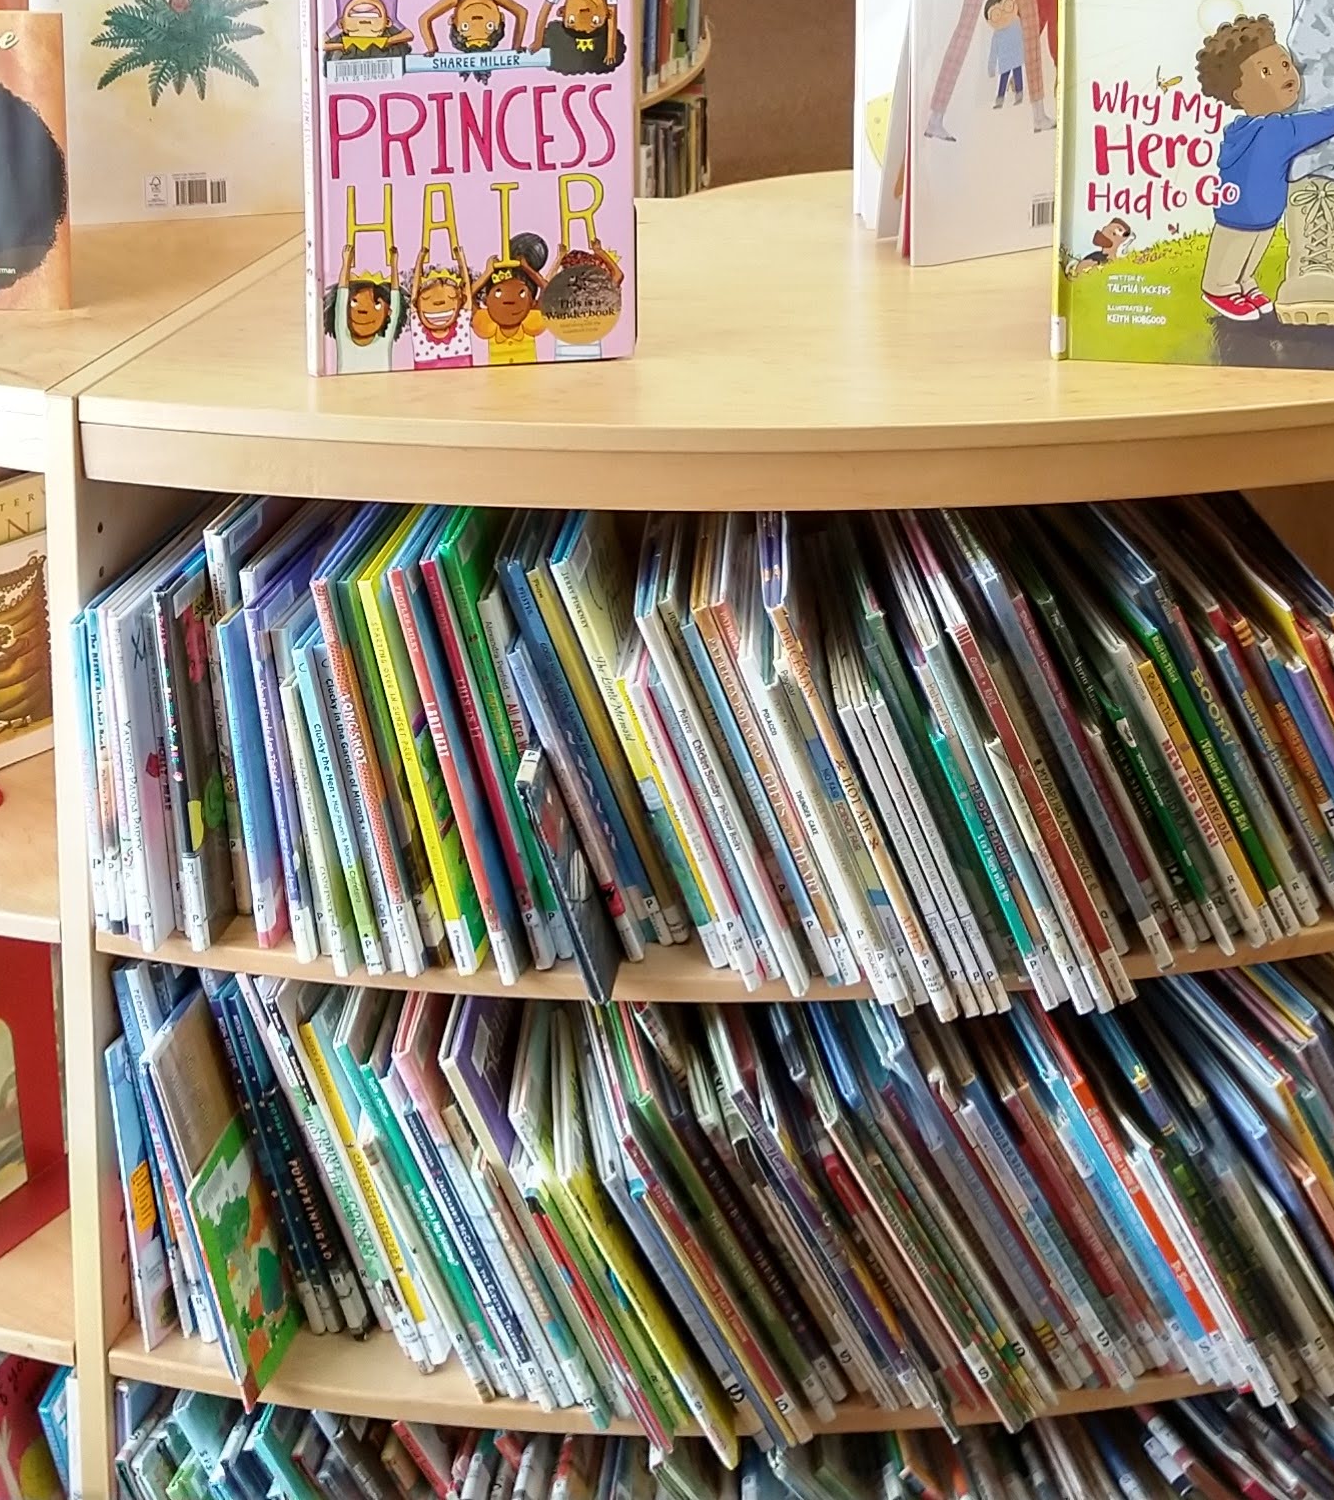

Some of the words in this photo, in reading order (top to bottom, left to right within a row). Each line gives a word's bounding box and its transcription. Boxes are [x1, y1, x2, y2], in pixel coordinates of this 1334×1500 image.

[432, 56, 476, 70] SHAREE
[479, 55, 520, 67] MILLER
[328, 83, 616, 180] PRINCESS
[1092, 80, 1161, 126] Why
[1171, 90, 1223, 134] My
[1094, 124, 1213, 178] Hero
[346, 172, 605, 268] HAIR
[1087, 181, 1153, 221] Had
[1160, 179, 1188, 212] to
[1195, 175, 1239, 207] Go
[545, 307, 616, 320] Wonderbook
[1107, 304, 1144, 312] ILLUSTRATED
[1108, 283, 1138, 294] TALITHA
[1141, 286, 1171, 295] VICKERS
[1107, 314, 1130, 324] KEITH
[1132, 315, 1167, 325] HOBGOOD
[485, 620, 499, 658] Alexandra
[561, 572, 575, 596] JERRY
[571, 596, 589, 629] PINKNEY
[594, 654, 608, 678] The
[601, 675, 618, 701] Little
[610, 701, 636, 744] Mermaid
[494, 659, 510, 691] Penfold
[339, 693, 357, 730] LONG
[349, 730, 367, 765] SHOT
[506, 703, 517, 717] All
[509, 718, 524, 745] Are
[779, 627, 816, 700] PRICEMAN
[841, 774, 862, 805] HOT
[852, 809, 874, 837] AIR
[1189, 666, 1233, 747] BOOM!
[314, 723, 326, 754] Clucky
[322, 754, 331, 775] the
[325, 678, 336, 710] Clucky
[340, 740, 353, 770] Garden
[351, 782, 365, 824] Mirrors
[326, 774, 335, 792] Hen
[691, 738, 710, 770] Chicken
[704, 769, 722, 799] Sunday
[706, 636, 736, 695] PATRICIA
[733, 697, 764, 761] POLACCO
[762, 773, 788, 817] GIFTS
[792, 845, 822, 896] HEART
[762, 707, 778, 736] POLACCO
[795, 789, 814, 820] THUNDER
[807, 819, 821, 838] CAKE
[1160, 737, 1180, 770] NEW
[1177, 770, 1198, 803] RED
[1193, 804, 1219, 848] BIKE!
[1190, 766, 1225, 821] TRAINING
[1218, 822, 1234, 846] DAY
[287, 1159, 333, 1261] PUMPKINHEAD
[352, 1153, 382, 1221] CARPENTER'S
[377, 1222, 402, 1263] HELPER
